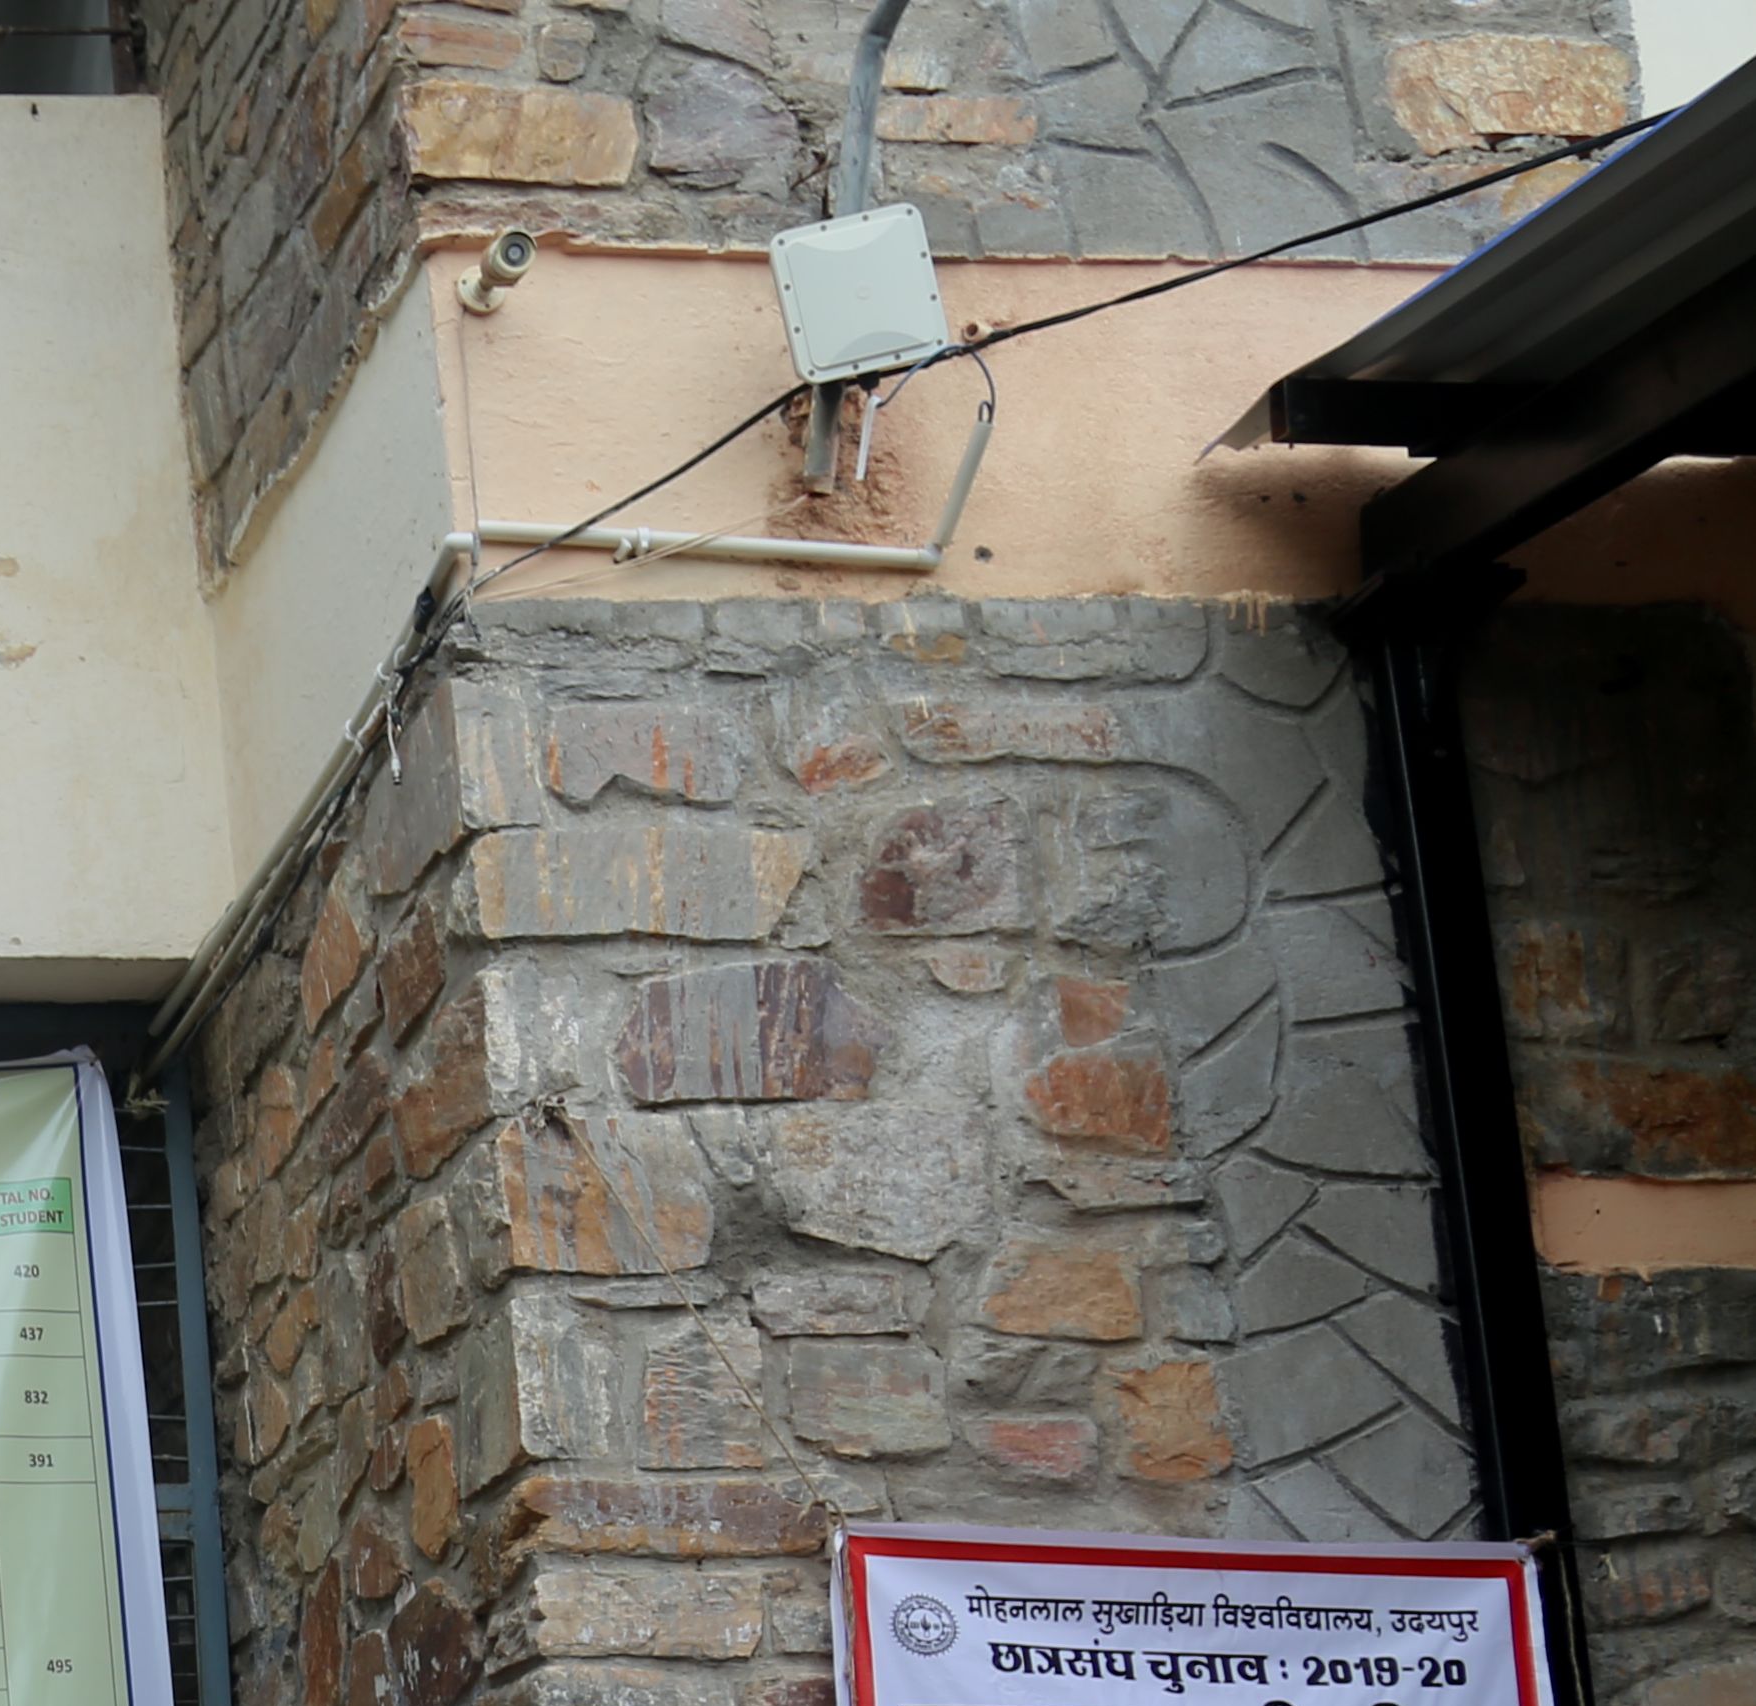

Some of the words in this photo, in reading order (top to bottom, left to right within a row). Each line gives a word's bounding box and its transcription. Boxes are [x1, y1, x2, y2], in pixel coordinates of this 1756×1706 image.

[28, 1188, 55, 1203] NO.
[0, 1209, 64, 1227] STUDENT
[19, 1327, 44, 1341] 437
[24, 1390, 49, 1404] 832
[965, 1585, 1086, 1623] मोहनलाल
[1092, 1591, 1207, 1634] सुखाड़िया
[1212, 1593, 1382, 1638] विश्वविद्यालय,
[1389, 1610, 1479, 1642] उदयपुर
[46, 1658, 73, 1674] 495
[988, 1638, 1137, 1680] छात्रसंघ
[1142, 1651, 1269, 1694] चुनाव
[1302, 1656, 1467, 1688] 2019-20
